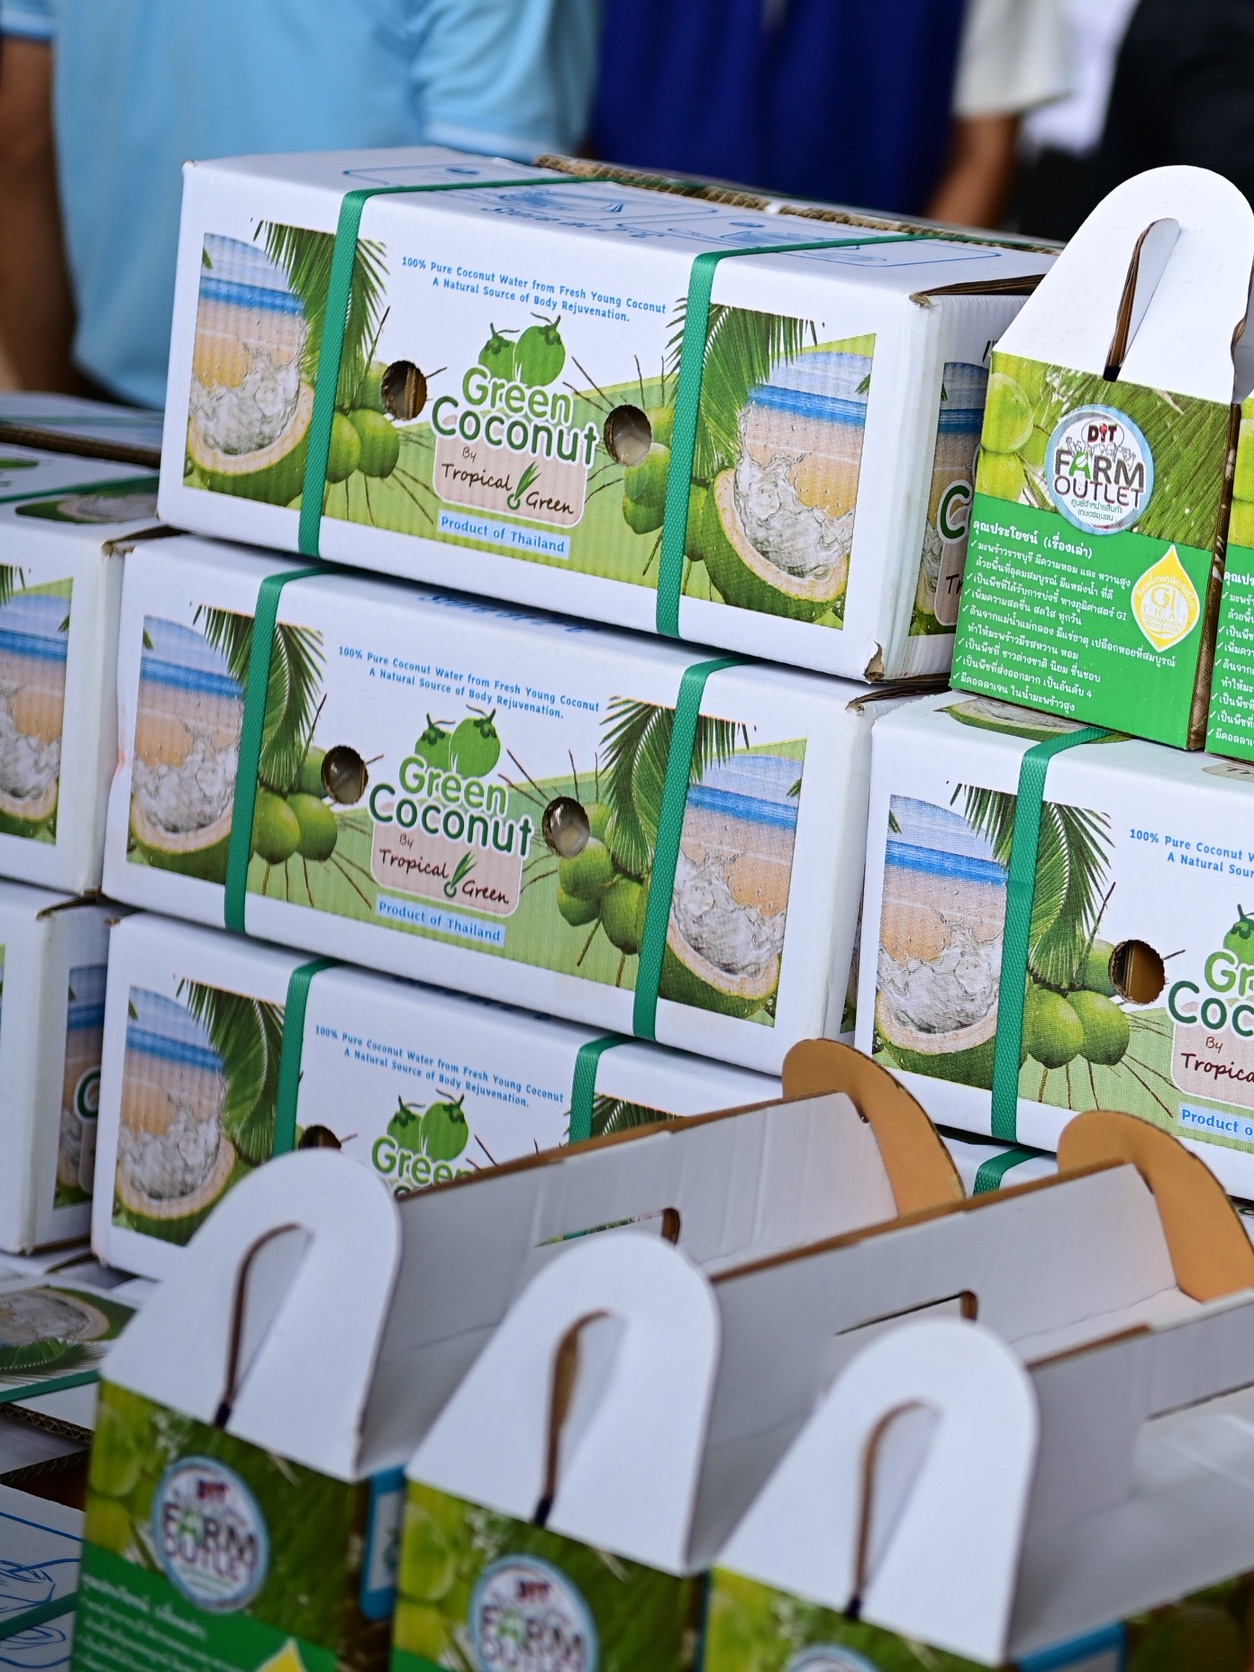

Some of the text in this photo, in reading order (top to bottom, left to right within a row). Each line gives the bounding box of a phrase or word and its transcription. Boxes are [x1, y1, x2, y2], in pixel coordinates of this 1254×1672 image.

[401, 256, 667, 314] 100% Pure Coconut Water from Fresh Young Coconut
[432, 277, 630, 323] A Natural Source of Body Rejuvenation.
[462, 367, 571, 423] Green
[431, 395, 597, 465] Coconut
[462, 447, 477, 463] By
[1054, 448, 1145, 493] FARM
[441, 463, 574, 515] Tropical Green
[1054, 476, 1143, 508] OUTLET
[441, 515, 565, 552] Product of Thailand
[973, 518, 1093, 559] คุณประโยชน์ (เรื่องเล่า)
[977, 542, 1131, 589] มะพร้าวราชบุรี มีความหอม และ หวานสูง
[1060, 576, 1098, 597] มีแหล่งน้ำ
[1101, 585, 1113, 600] ที่ดี
[1060, 596, 1115, 617] ทางภูมิศาสตร์
[1116, 610, 1127, 621] GI
[1033, 602, 1056, 618] สดใส
[1058, 608, 1082, 627] ทุกวัน
[1056, 627, 1089, 647] มีแร่ธาตุ
[1060, 647, 1079, 660] หอม
[338, 646, 600, 712] 100% Pure Coconut Water from Fresh Young Coconut
[965, 636, 1101, 683] เป็นพืชที่ ชาวต่างชาติ นิยม ชื่นชอบ
[369, 667, 564, 719] A Natural Source of Body Rejuvenation.
[960, 671, 1009, 694] มีคอลลาเจน
[1043, 674, 1085, 696] เป็นอันดับ
[1086, 689, 1093, 699] 4
[399, 756, 507, 815] Green
[369, 783, 532, 856] Coconut
[399, 833, 414, 849] By
[1129, 828, 1160, 844] 100%
[1164, 835, 1191, 850] Pure
[1196, 842, 1243, 860] Coconut
[379, 849, 509, 904] Tropical Green
[1167, 852, 1175, 863] A
[1180, 853, 1223, 872] Natural
[379, 901, 501, 942] Product of Thailand
[315, 1025, 564, 1103] 100% Pure Coconut Water from Fresh Young Coconut
[1205, 1036, 1224, 1053] By
[344, 1048, 530, 1108] A Natural Source of Body Rejuvenation.
[1181, 1108, 1240, 1133] Product
